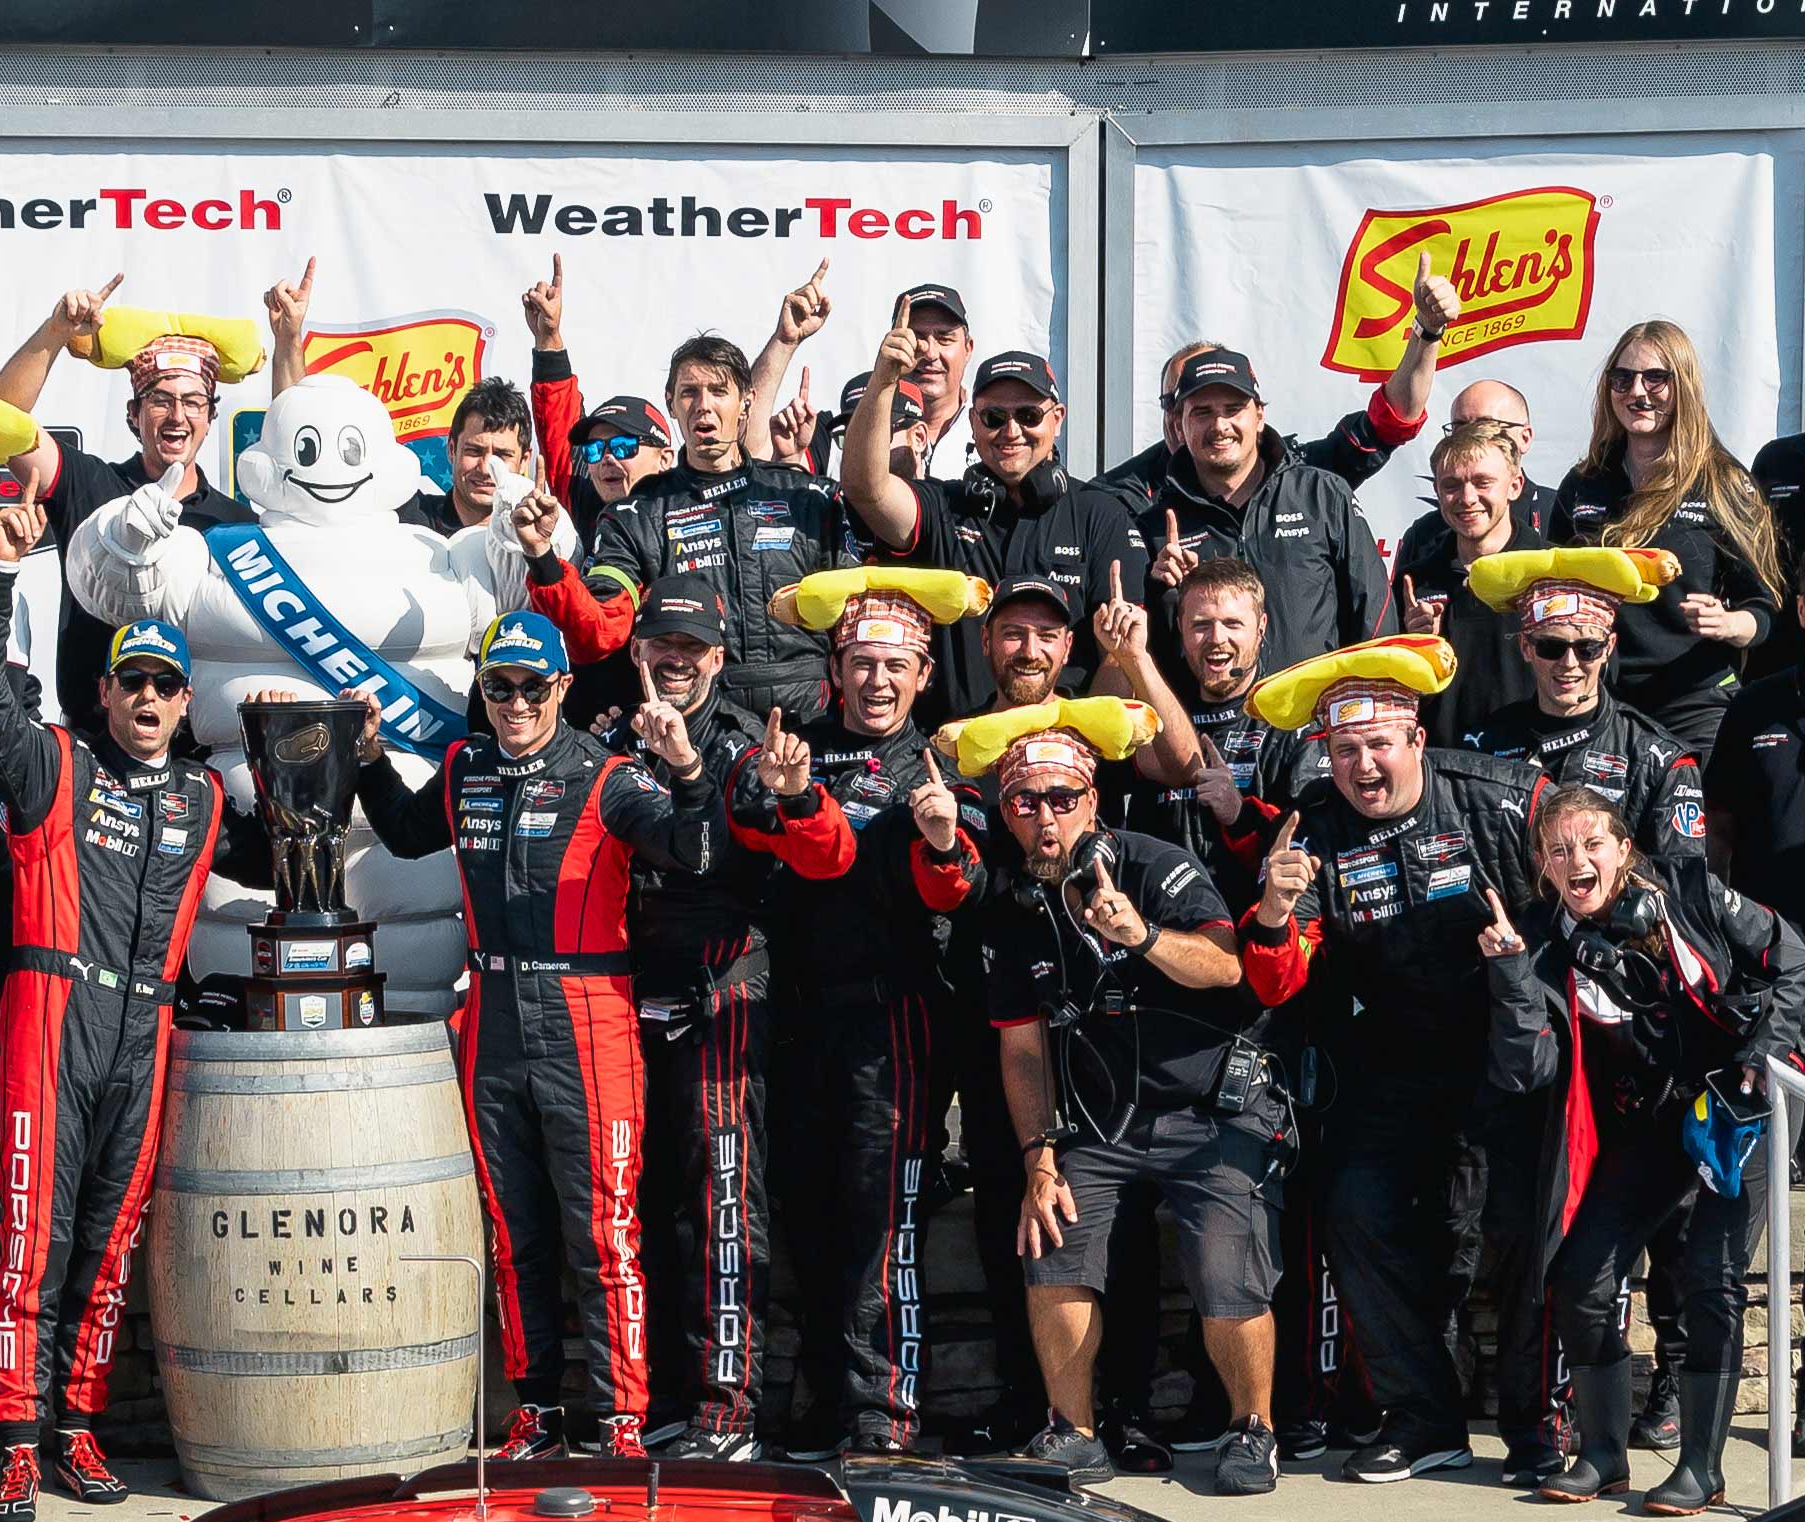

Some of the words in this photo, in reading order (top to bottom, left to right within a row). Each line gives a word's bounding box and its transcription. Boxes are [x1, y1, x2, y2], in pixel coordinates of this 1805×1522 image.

[484, 193, 982, 240] WeatherTech
[1353, 219, 1572, 338] Shlen's
[1483, 315, 1526, 336] 1869
[398, 415, 431, 431] 1869
[703, 477, 747, 500] HELLER
[1276, 512, 1303, 523] BOSS
[1674, 509, 1705, 522] Ansys
[1274, 527, 1310, 538] Ansys
[676, 538, 722, 555] Ansys
[1055, 546, 1080, 556] BOSS
[677, 556, 712, 574] Mobil
[1048, 571, 1081, 584] Ansys
[1193, 709, 1237, 724] HELLER
[1542, 730, 1590, 753] HELLER
[825, 751, 873, 763] HELLER
[497, 759, 546, 776] HELLER
[91, 809, 140, 838] Ansys
[461, 815, 502, 833] Ansys
[1369, 817, 1418, 845] HELLER
[86, 828, 123, 854] Mobil
[459, 837, 487, 850] Mobil
[1350, 885, 1398, 903] Ansys
[1352, 910, 1389, 923] Mobil
[533, 958, 575, 972] Cameron
[212, 1202, 418, 1238] GLENORA
[611, 1119, 644, 1360] PORSCHE
[268, 1256, 361, 1275] WINE
[718, 1132, 738, 1383] PORSCHE
[896, 1158, 923, 1411] PORSCHE
[235, 1285, 399, 1305] CELLARS
